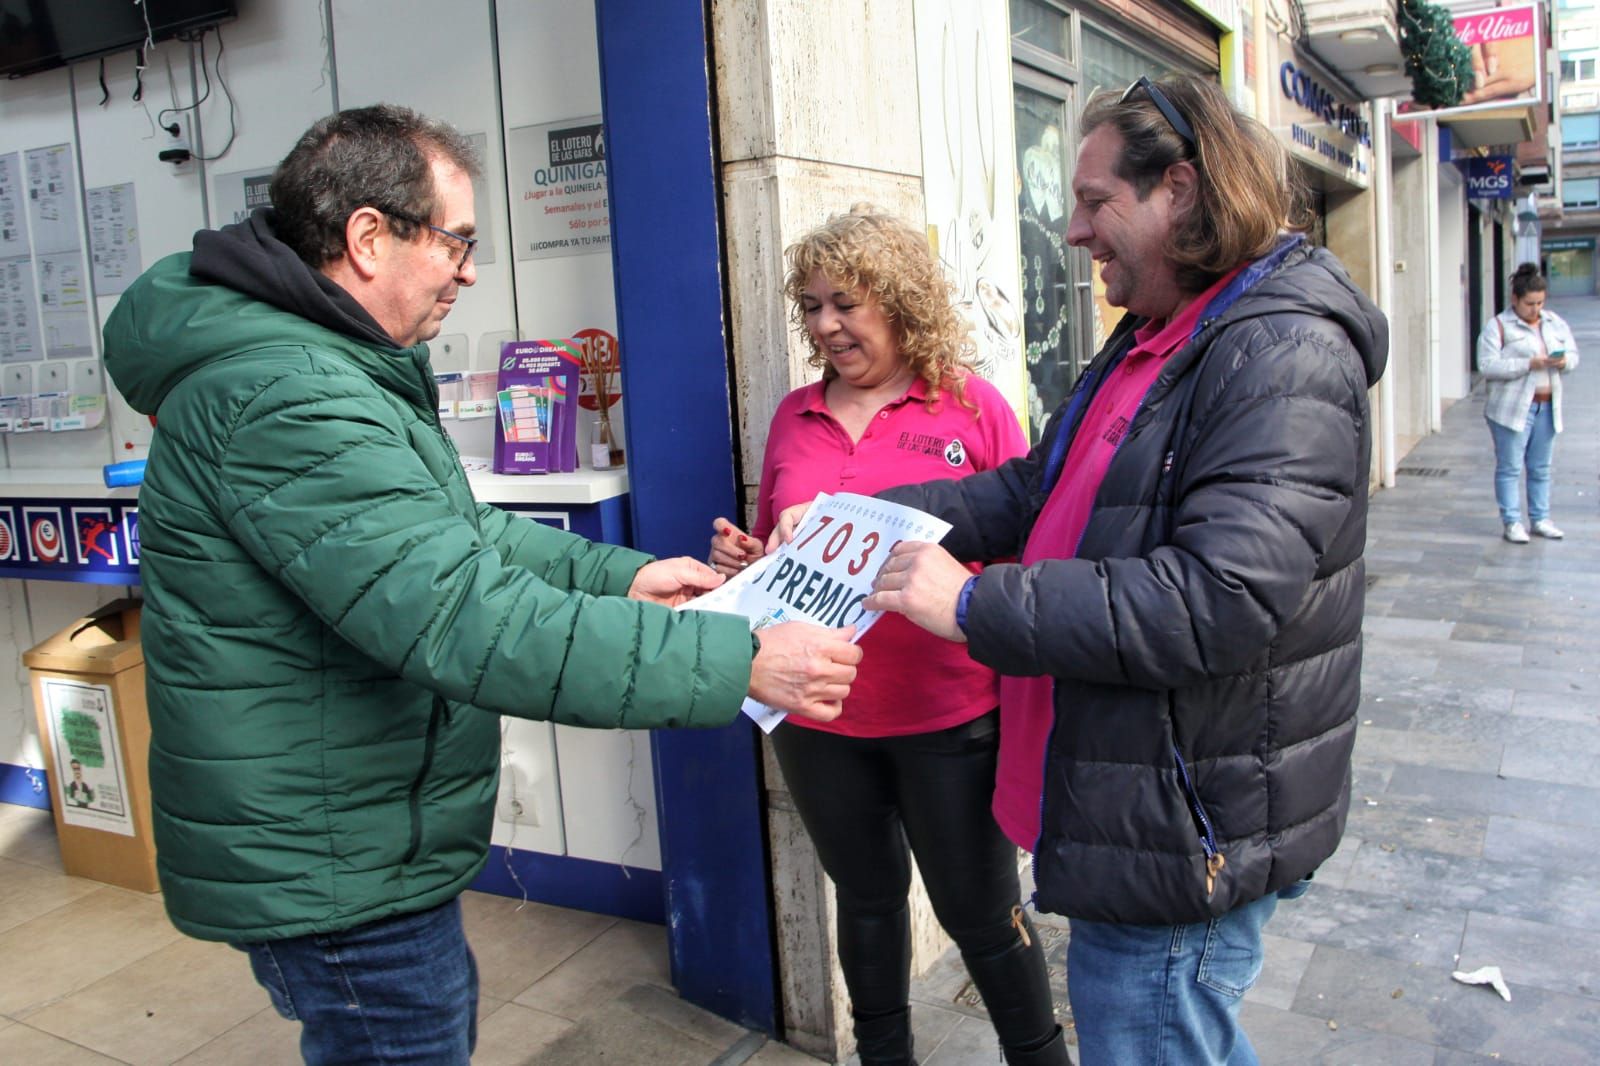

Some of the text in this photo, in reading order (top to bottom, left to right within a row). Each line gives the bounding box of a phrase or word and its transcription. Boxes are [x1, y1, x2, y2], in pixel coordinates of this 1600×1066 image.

[1478, 15, 1529, 40] Uñas
[551, 135, 592, 152] EL LOTERO
[552, 148, 593, 162] DE LAS GAFAS
[564, 182, 602, 195] QUINIELA
[1470, 175, 1509, 189] MGS
[544, 203, 586, 215] Semanales
[569, 218, 586, 230] Sólo
[570, 238, 580, 246] YA
[581, 236, 591, 245] TU
[900, 431, 946, 449] EL LOTERO
[766, 556, 869, 629] PREMIO
